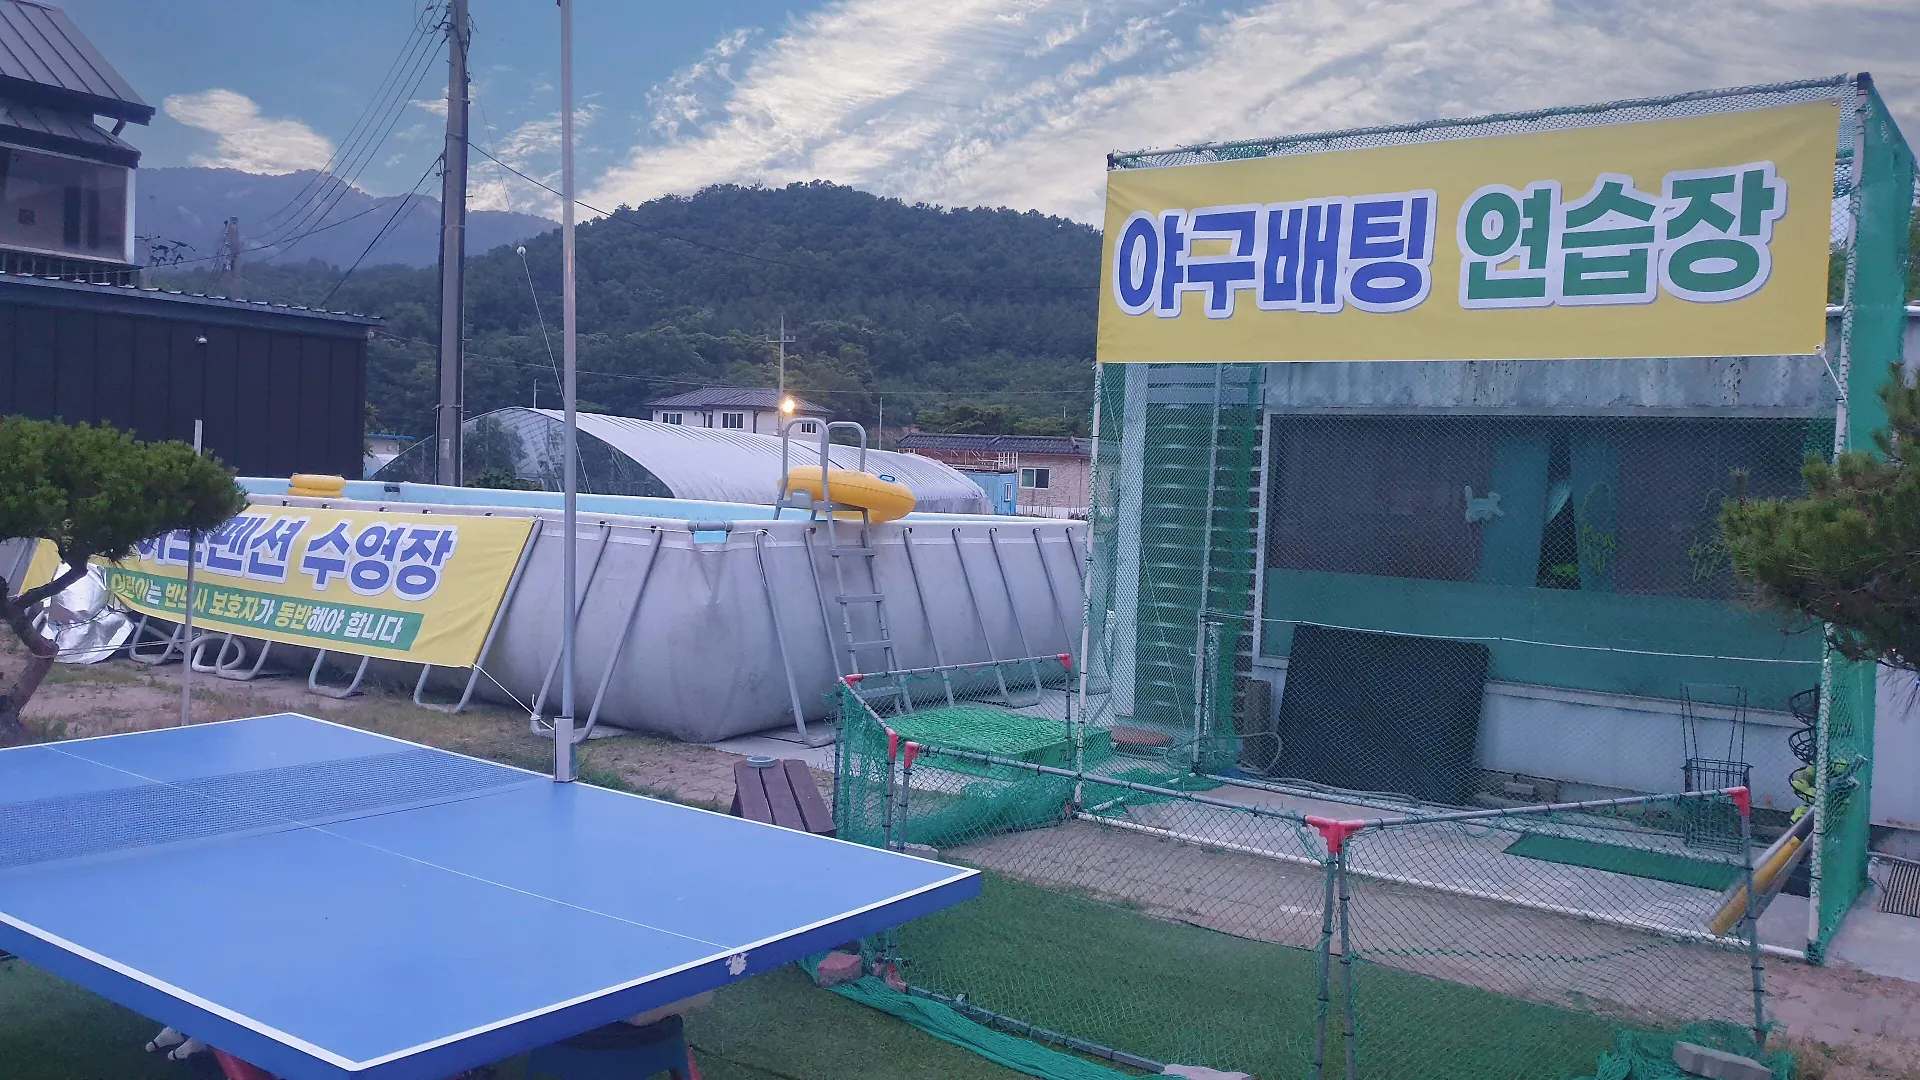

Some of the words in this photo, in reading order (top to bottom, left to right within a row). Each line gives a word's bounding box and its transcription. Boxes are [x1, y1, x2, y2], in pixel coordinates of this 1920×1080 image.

[1115, 190, 1437, 318] 야구배팅
[1457, 161, 1786, 309] 연습장
[300, 518, 458, 600] 수영장
[209, 591, 275, 624] 보호자가
[275, 601, 345, 634] 동반해야
[343, 611, 404, 643] 합니다
